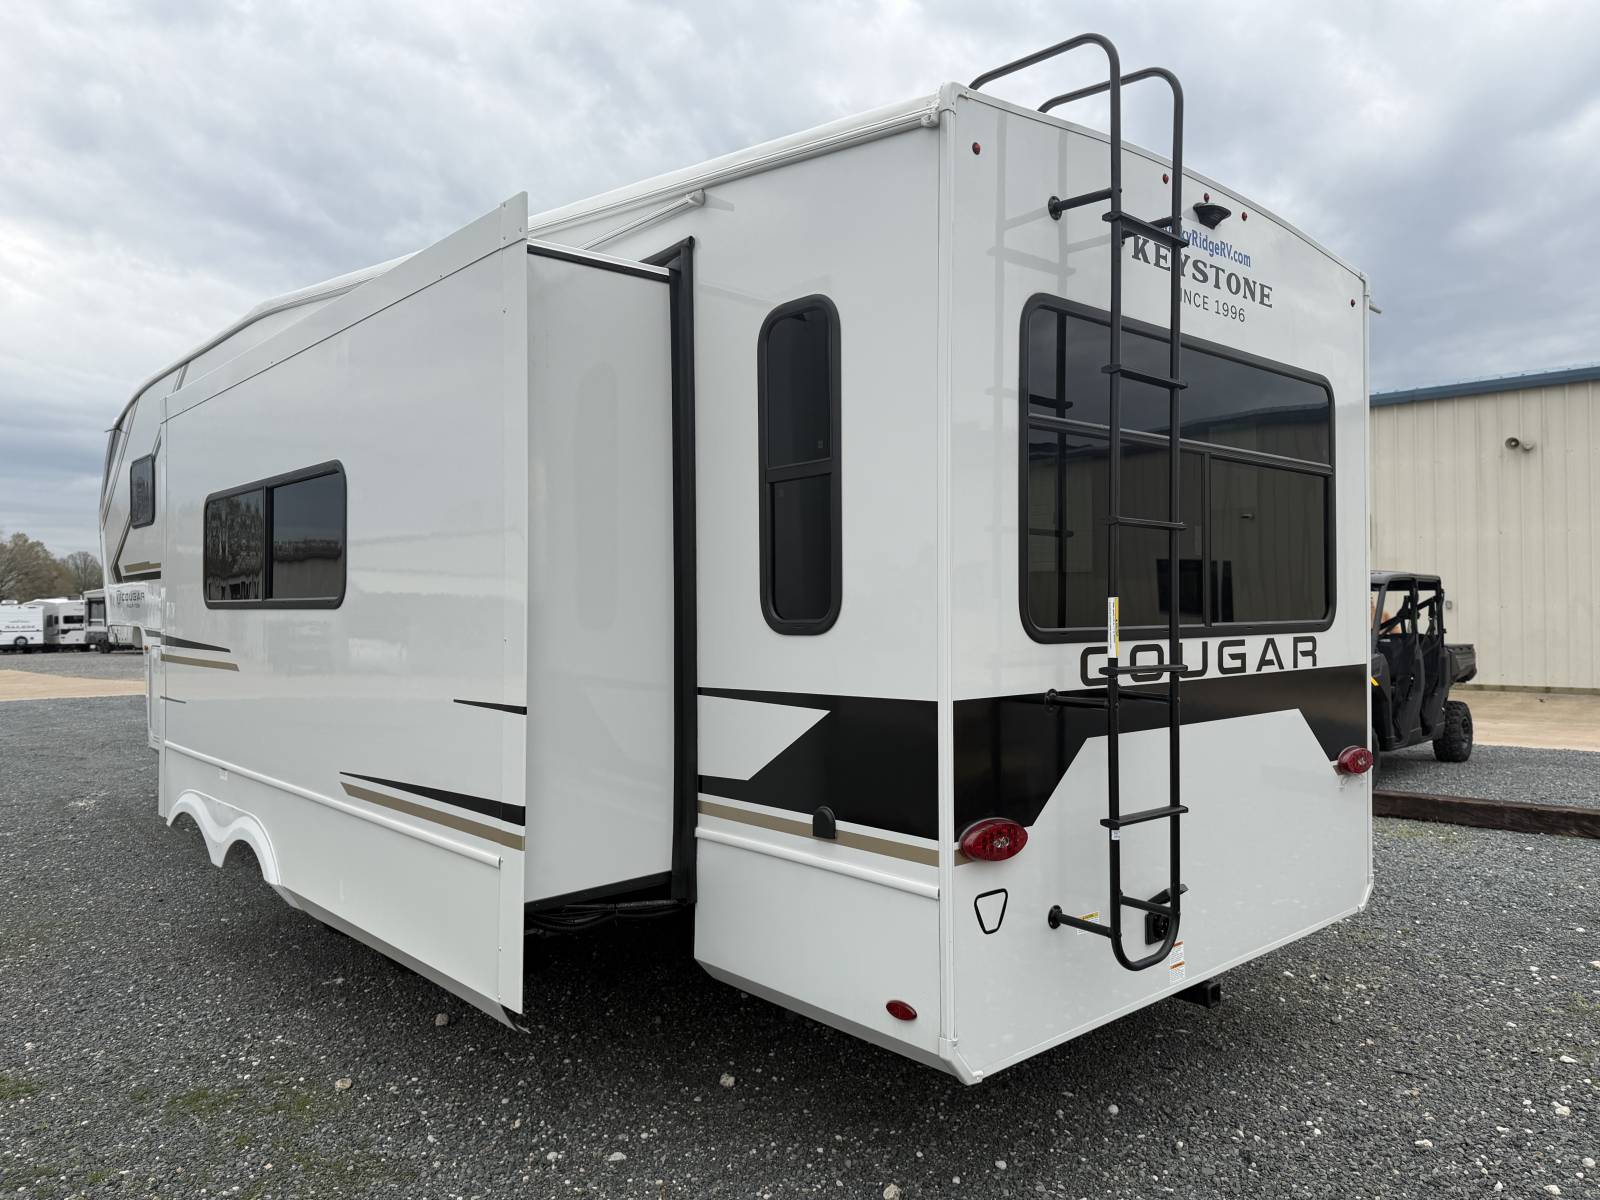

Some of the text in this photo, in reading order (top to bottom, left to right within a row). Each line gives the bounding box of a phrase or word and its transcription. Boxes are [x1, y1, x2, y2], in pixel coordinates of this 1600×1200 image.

[1131, 235, 1272, 309] KEYSTONE
[1214, 299, 1246, 323] 1996
[1080, 635, 1318, 687] COUGAR
